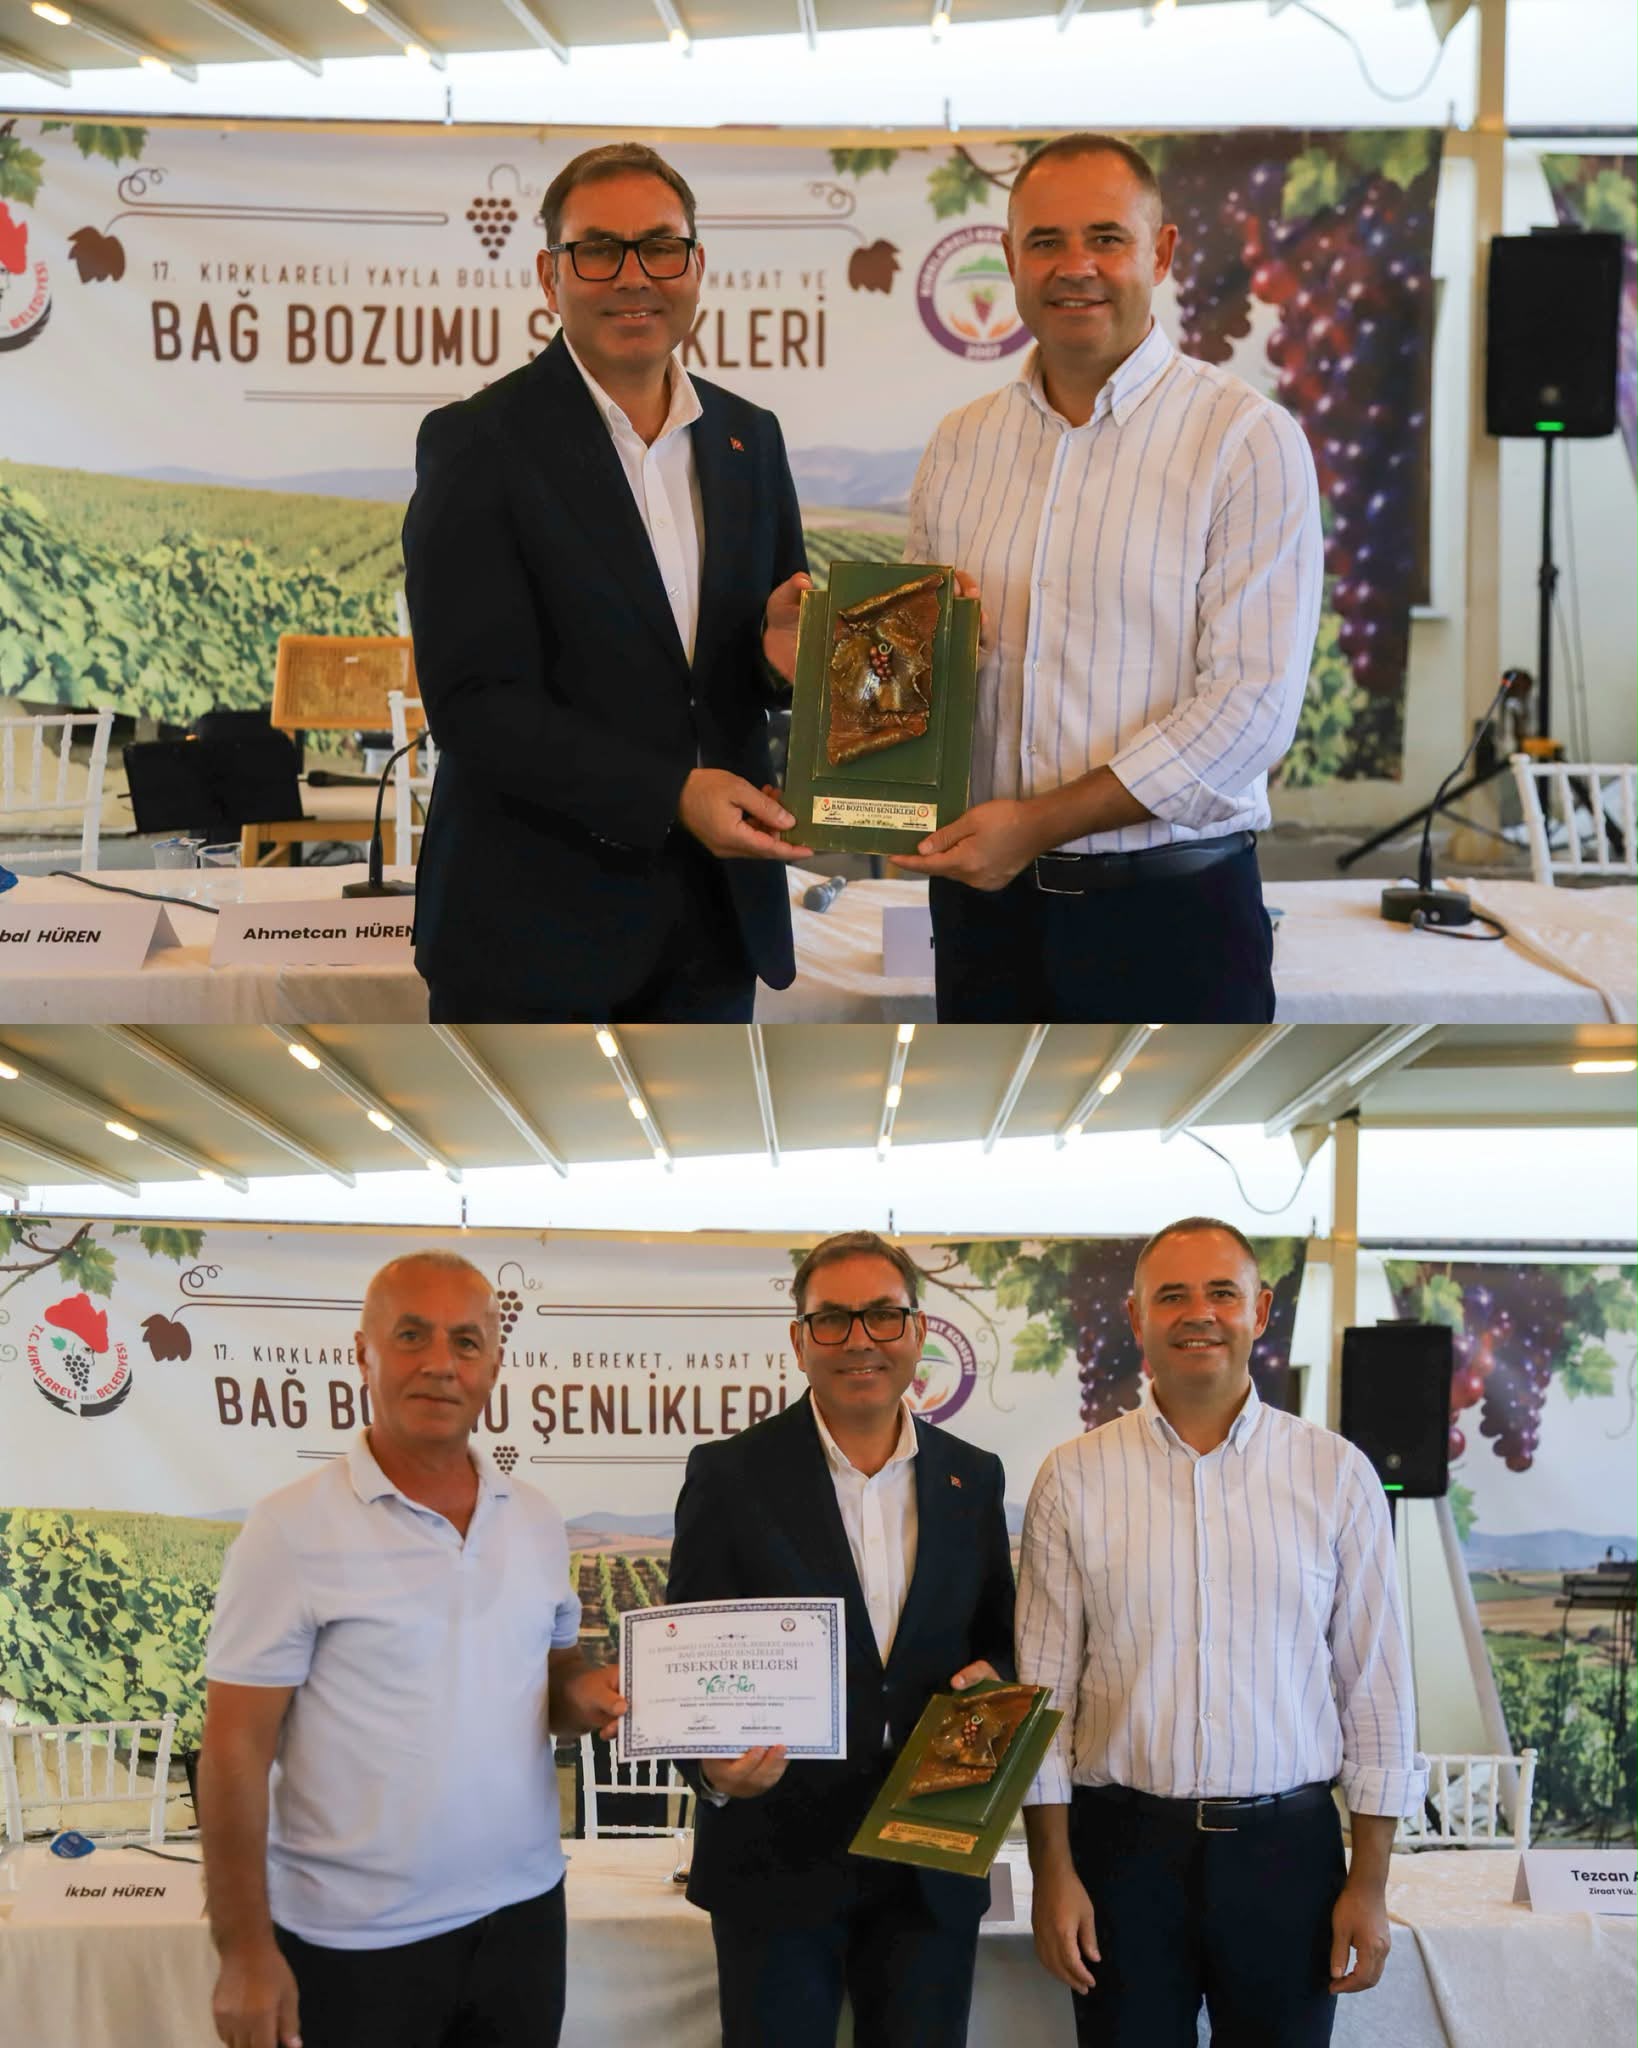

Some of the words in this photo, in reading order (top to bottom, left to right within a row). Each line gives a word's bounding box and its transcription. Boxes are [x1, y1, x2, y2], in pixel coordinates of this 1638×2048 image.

[200, 261, 349, 286] KIRKLARELİ
[366, 268, 440, 288] YAYLA
[456, 269, 541, 289] BOLLU
[708, 270, 782, 290] HASAT
[802, 269, 826, 290] VE
[151, 289, 259, 364] BAĞ
[287, 303, 500, 367] BOZUMU
[0, 930, 31, 943] bal
[36, 927, 101, 944] HÜREN
[243, 927, 347, 940] Ahmetcan
[214, 1344, 235, 1361] 17.
[253, 1346, 355, 1366] KIRKLARE
[573, 1352, 672, 1370] BEREKET,
[687, 1353, 750, 1369] HASAT
[765, 1353, 788, 1370] VE
[27, 1345, 77, 1400] KIRKLARELİ
[215, 1368, 308, 1429] BAĞ
[531, 1372, 787, 1445] ŞENLİKLERİ
[665, 1658, 739, 1675] TEŞEKKÜR
[742, 1658, 799, 1672] BELGESİ
[1570, 1870, 1630, 1882] Tezcan
[112, 1884, 166, 1898] HÜREN
[1588, 1887, 1616, 1896] Ziraat
[1616, 1887, 1637, 1896] Yük.
